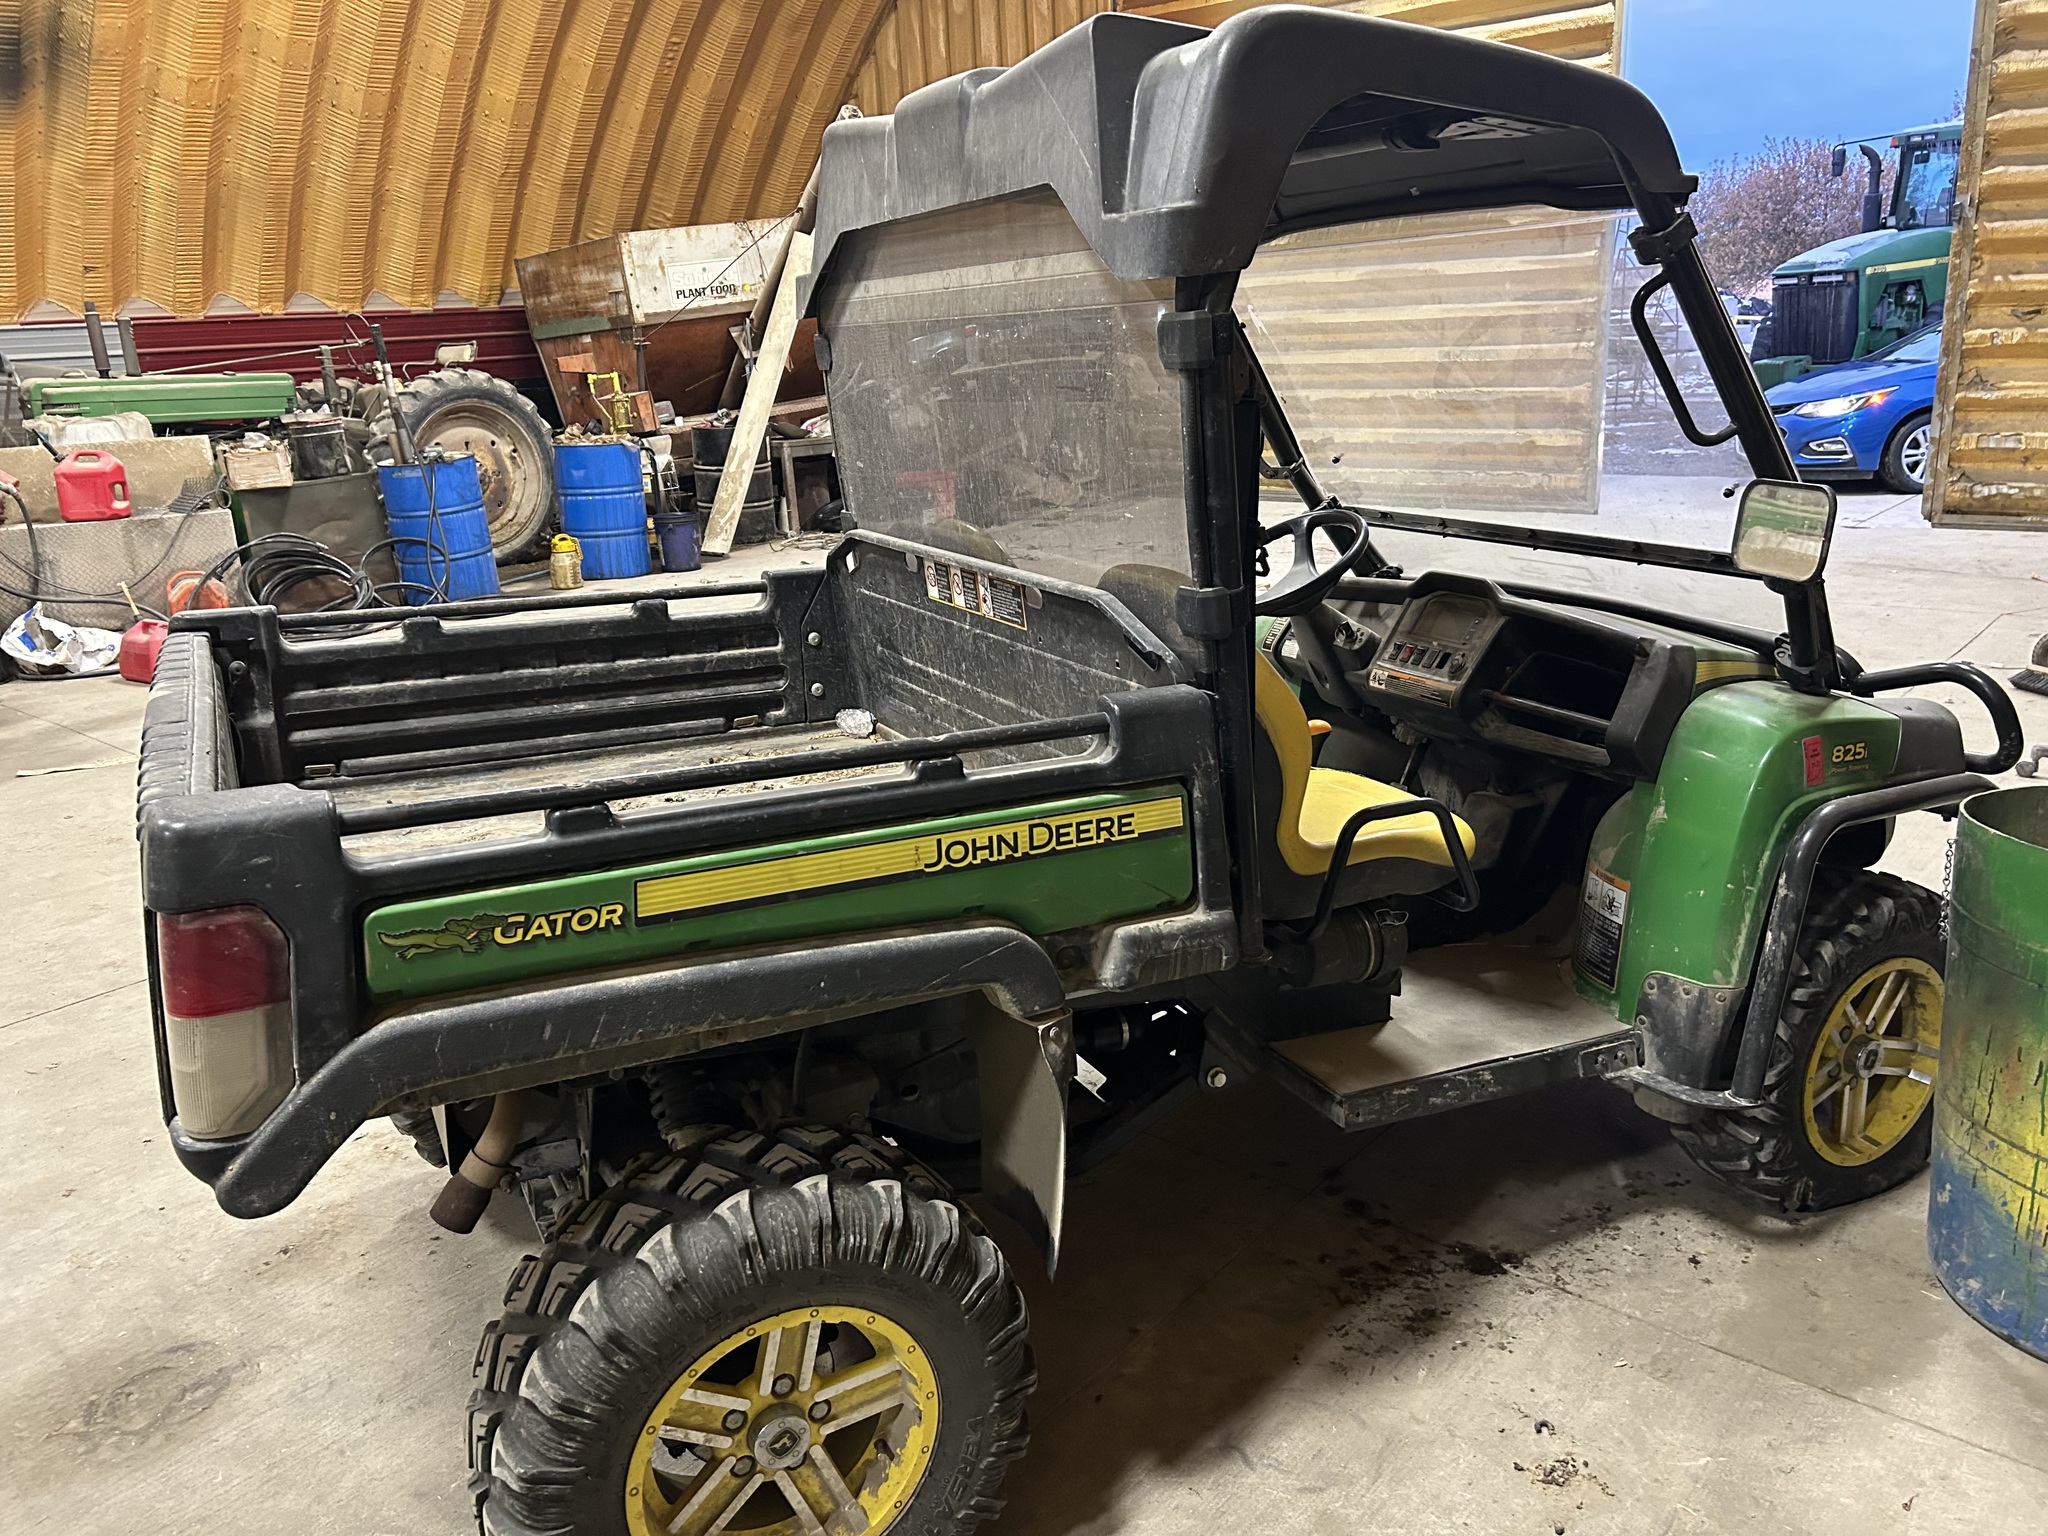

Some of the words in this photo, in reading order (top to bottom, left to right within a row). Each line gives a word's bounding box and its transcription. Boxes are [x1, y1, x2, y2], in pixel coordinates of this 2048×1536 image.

[676, 287, 707, 299] PLANT
[710, 283, 737, 296] FOOD
[1831, 742, 1868, 762] 825i
[1027, 812, 1138, 854] DEERE
[493, 902, 625, 945] GATOR
